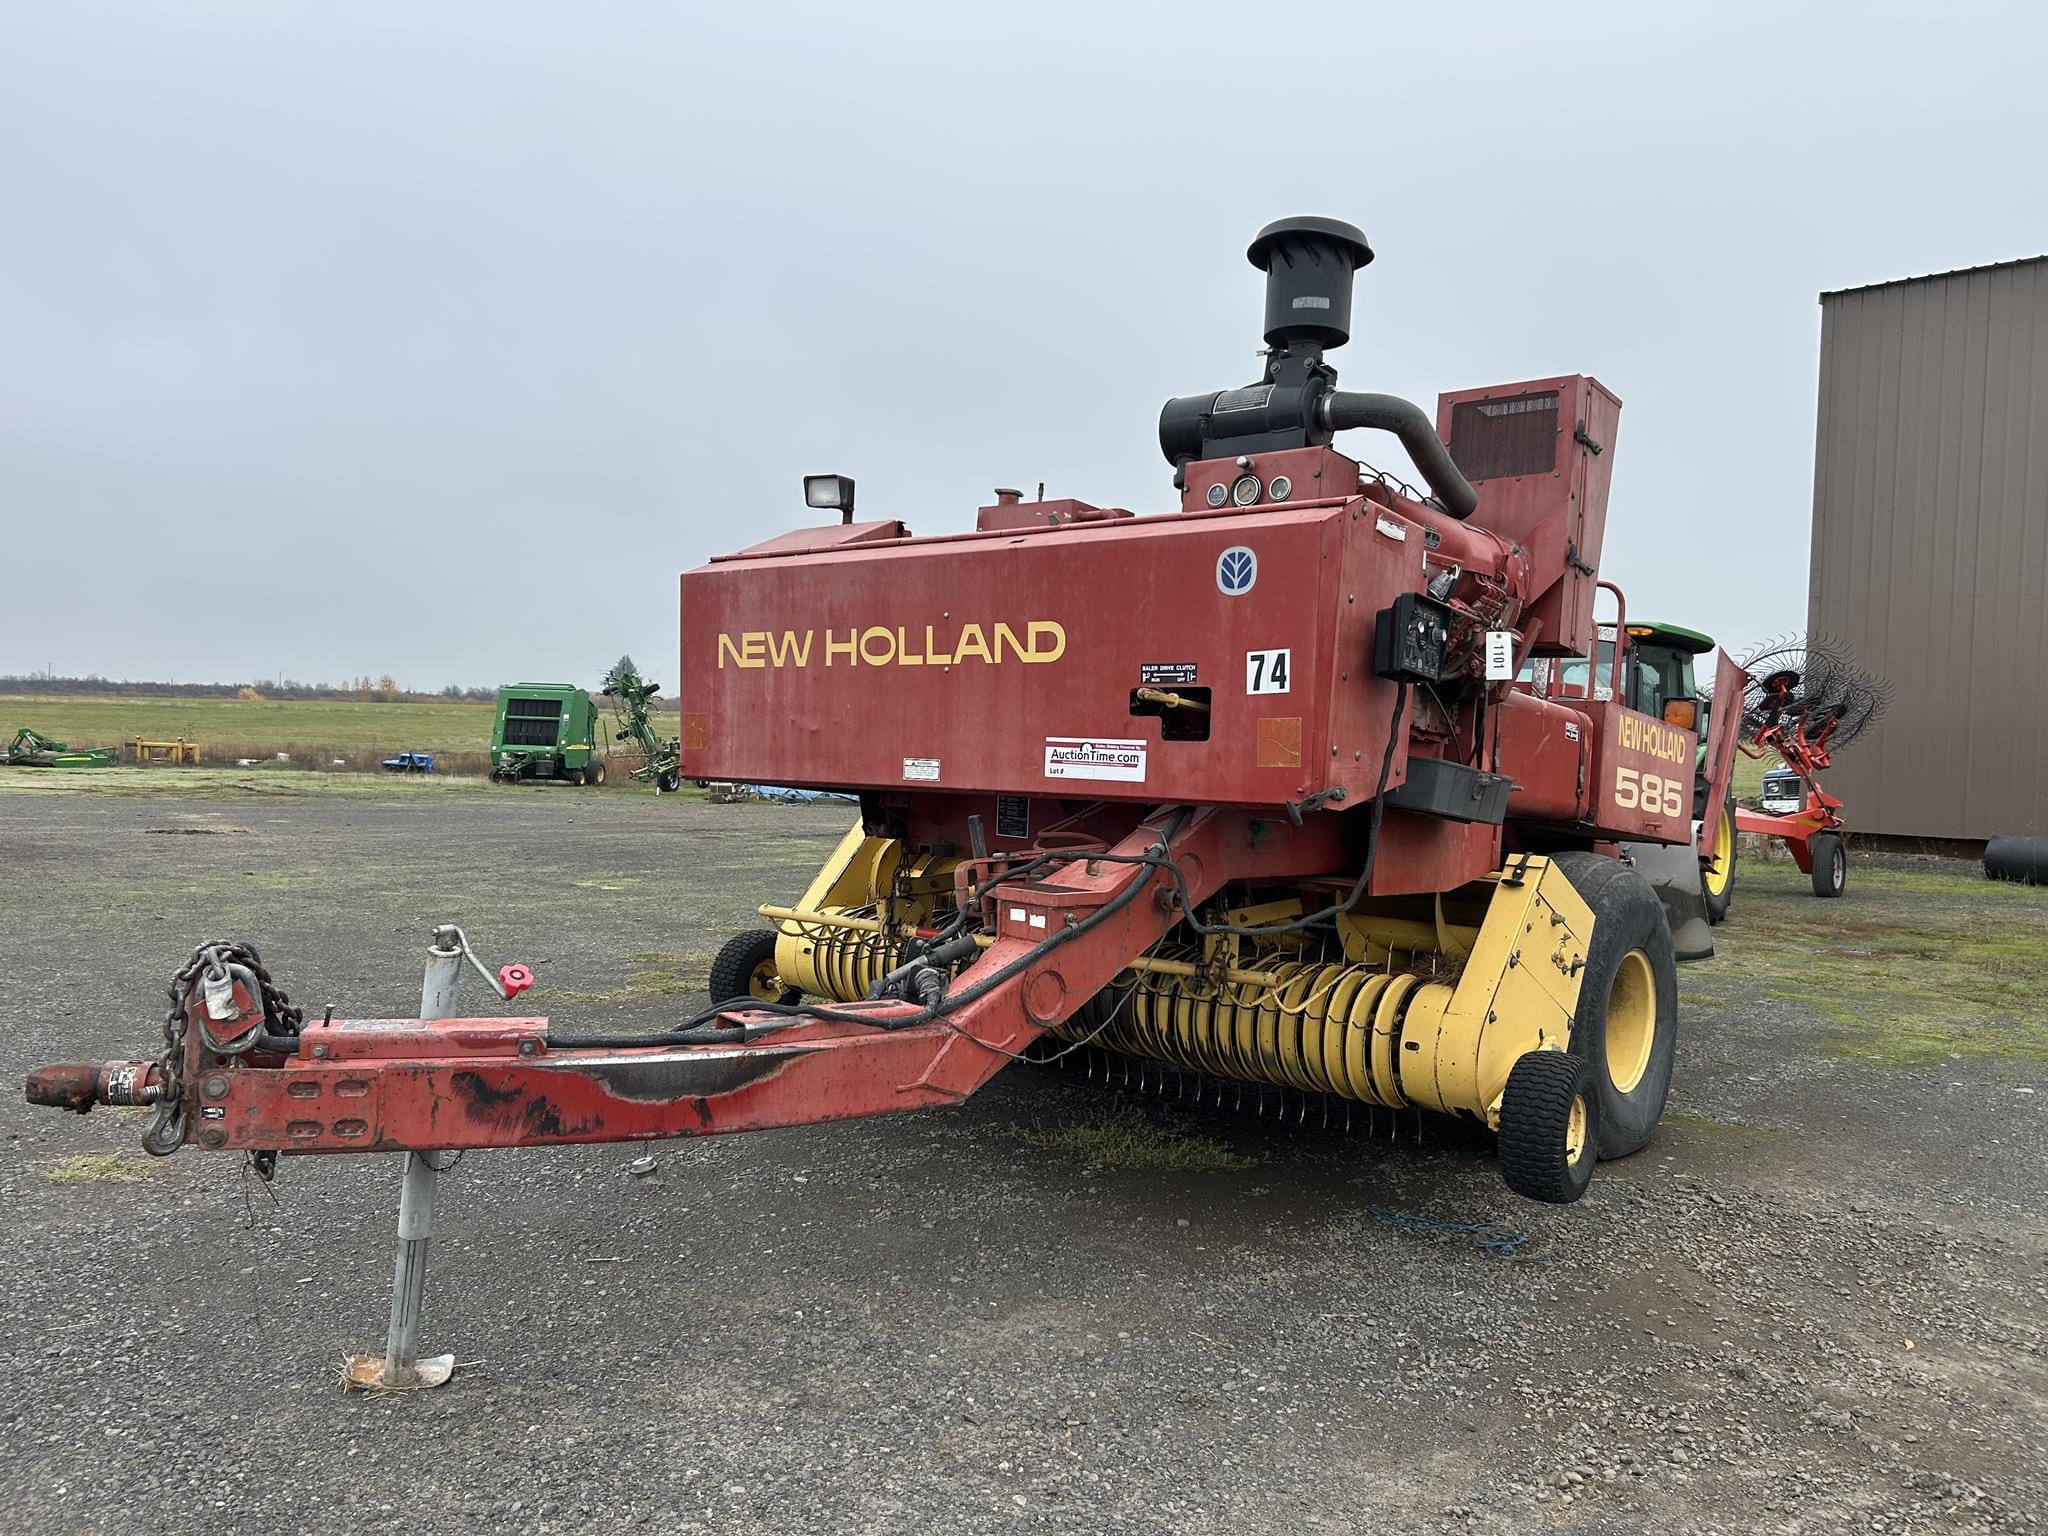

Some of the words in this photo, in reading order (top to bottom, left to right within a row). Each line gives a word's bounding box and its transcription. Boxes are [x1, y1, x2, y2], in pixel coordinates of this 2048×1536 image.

[718, 630, 814, 669] NEW
[825, 621, 1066, 667] HOLLAND
[1493, 645, 1504, 669] 1101
[1250, 653, 1287, 691] 74
[1051, 749, 1139, 763] AuctionTime.com
[1618, 714, 1642, 751] NEW
[1642, 722, 1685, 765] HOLLAND
[1615, 767, 1682, 817] 585
